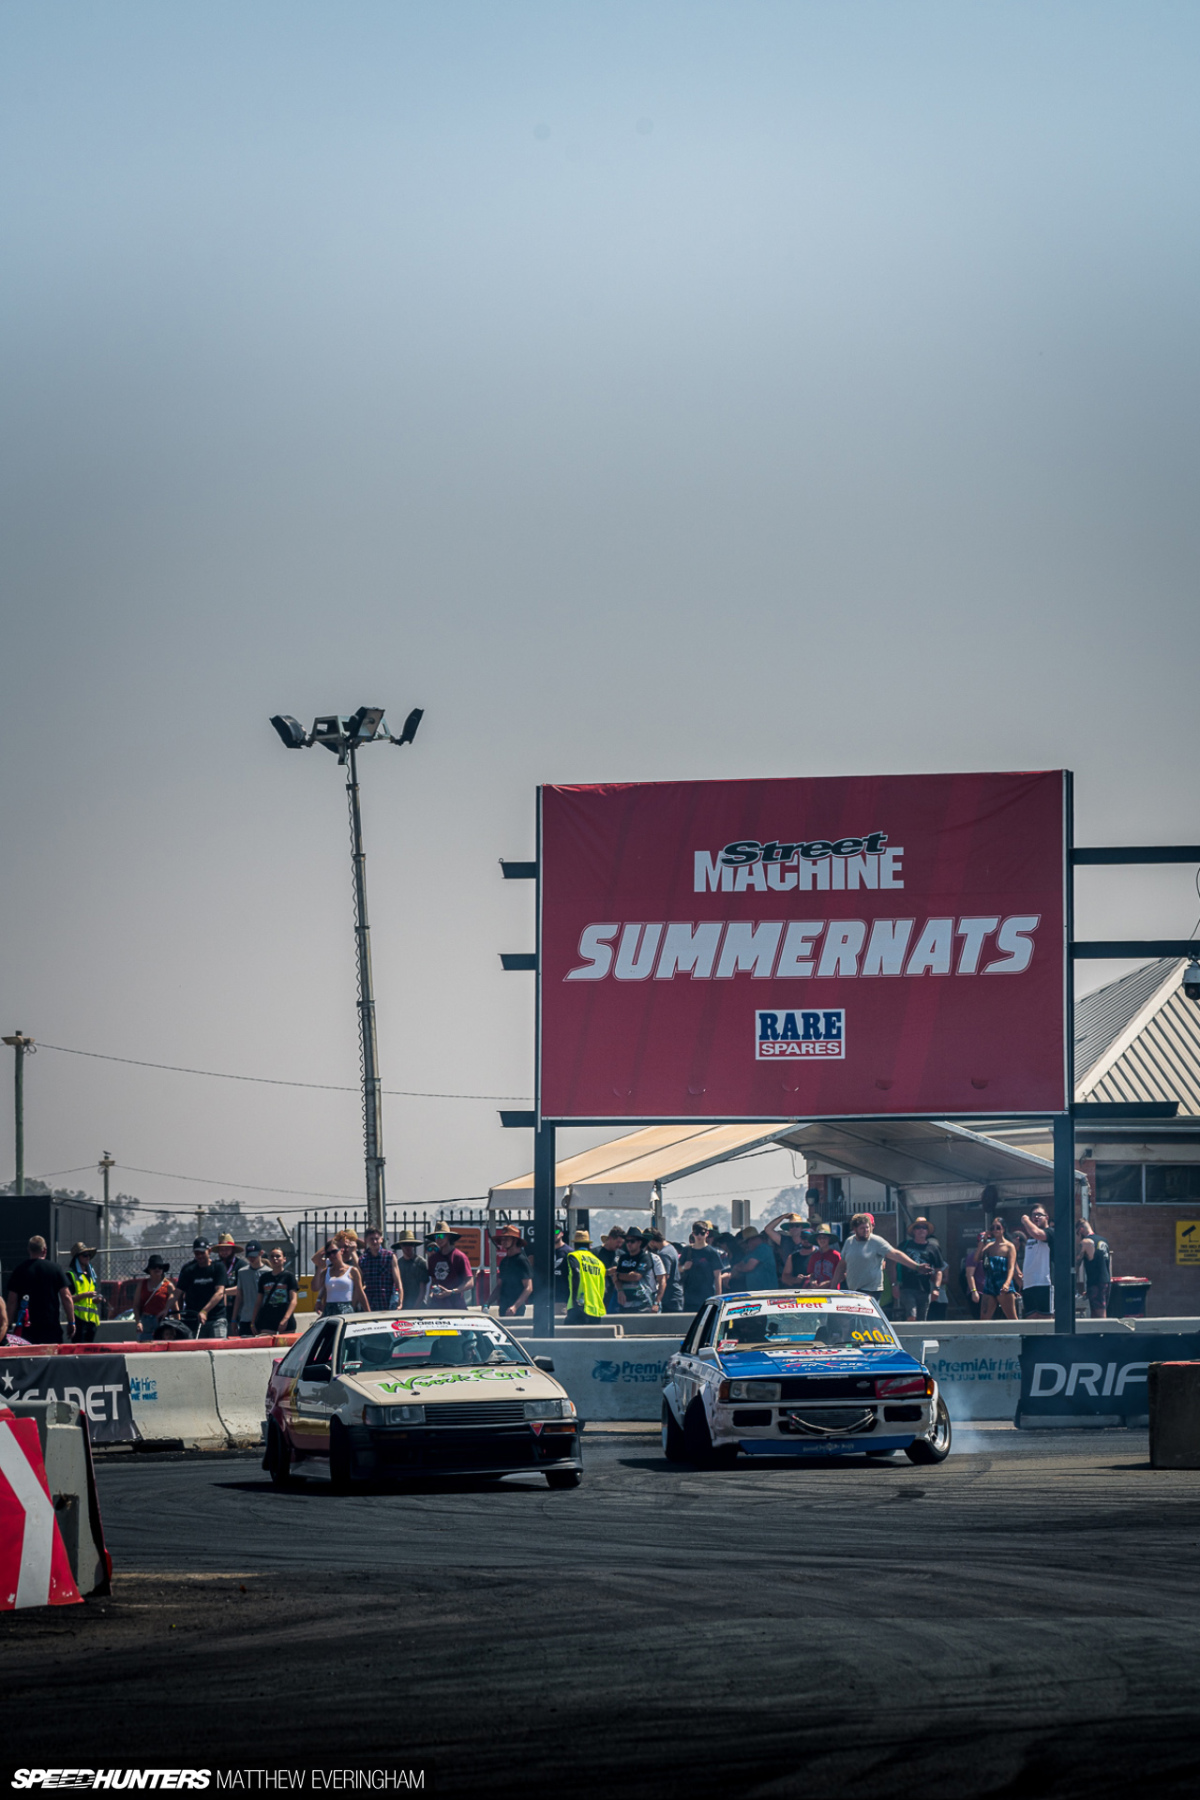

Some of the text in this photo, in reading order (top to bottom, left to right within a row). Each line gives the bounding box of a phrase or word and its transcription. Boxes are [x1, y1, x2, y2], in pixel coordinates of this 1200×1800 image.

[720, 830, 889, 868] Street
[693, 846, 904, 893] MACHINE
[562, 913, 1042, 983] SUMMERNATS
[758, 1012, 843, 1041] RARE
[760, 1041, 841, 1057] SPARES
[482, 1330, 513, 1346] 12
